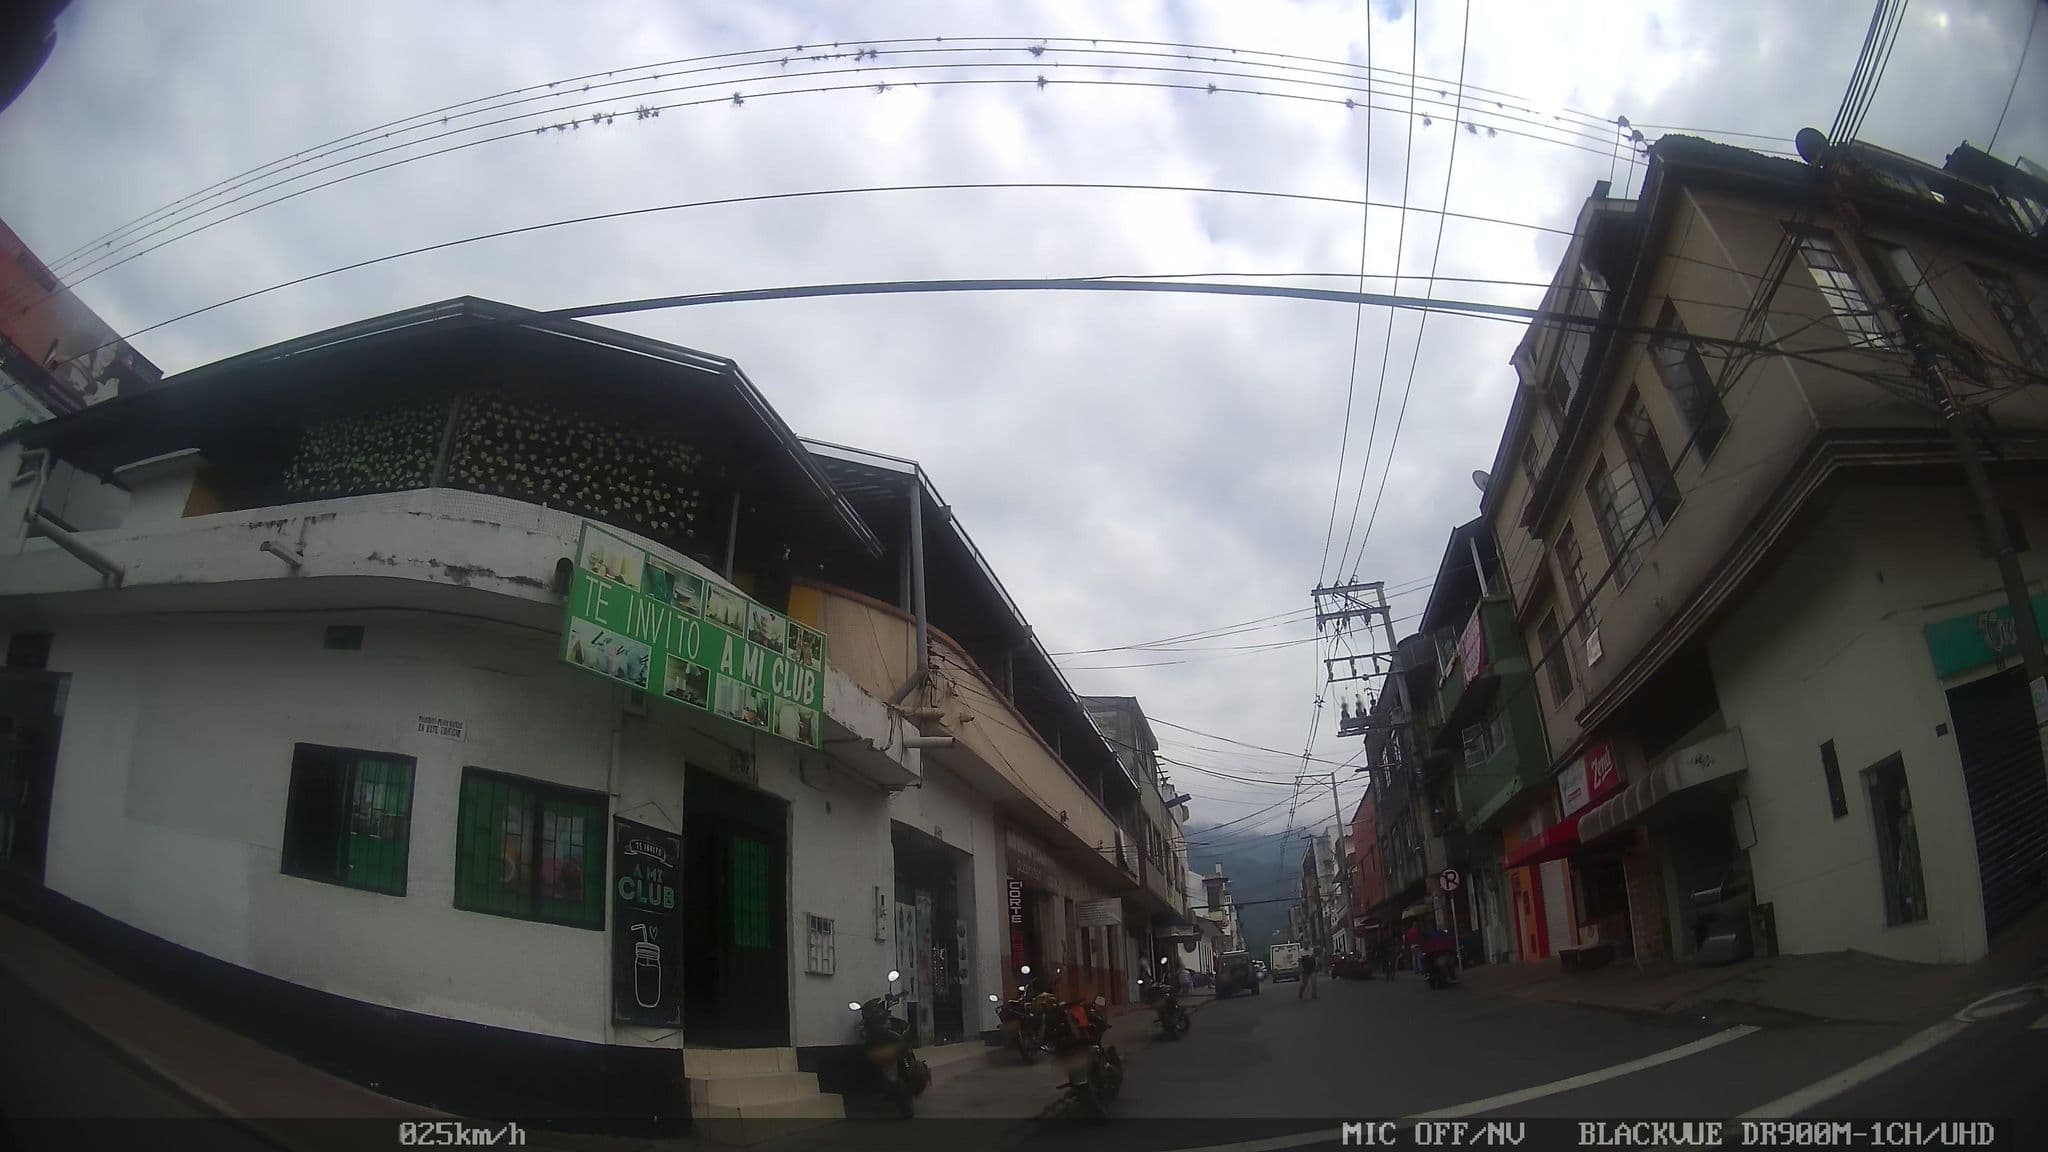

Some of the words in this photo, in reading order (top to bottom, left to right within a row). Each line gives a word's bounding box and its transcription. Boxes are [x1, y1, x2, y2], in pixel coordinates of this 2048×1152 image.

[586, 575, 612, 624] TE
[626, 594, 700, 660] INVITO
[720, 634, 733, 676] A
[742, 643, 766, 687] MI
[771, 657, 815, 705] CLUB
[633, 863, 643, 879] A
[647, 865, 663, 882] MI
[618, 876, 675, 909] CLUB
[1008, 880, 1024, 924] CORTE
